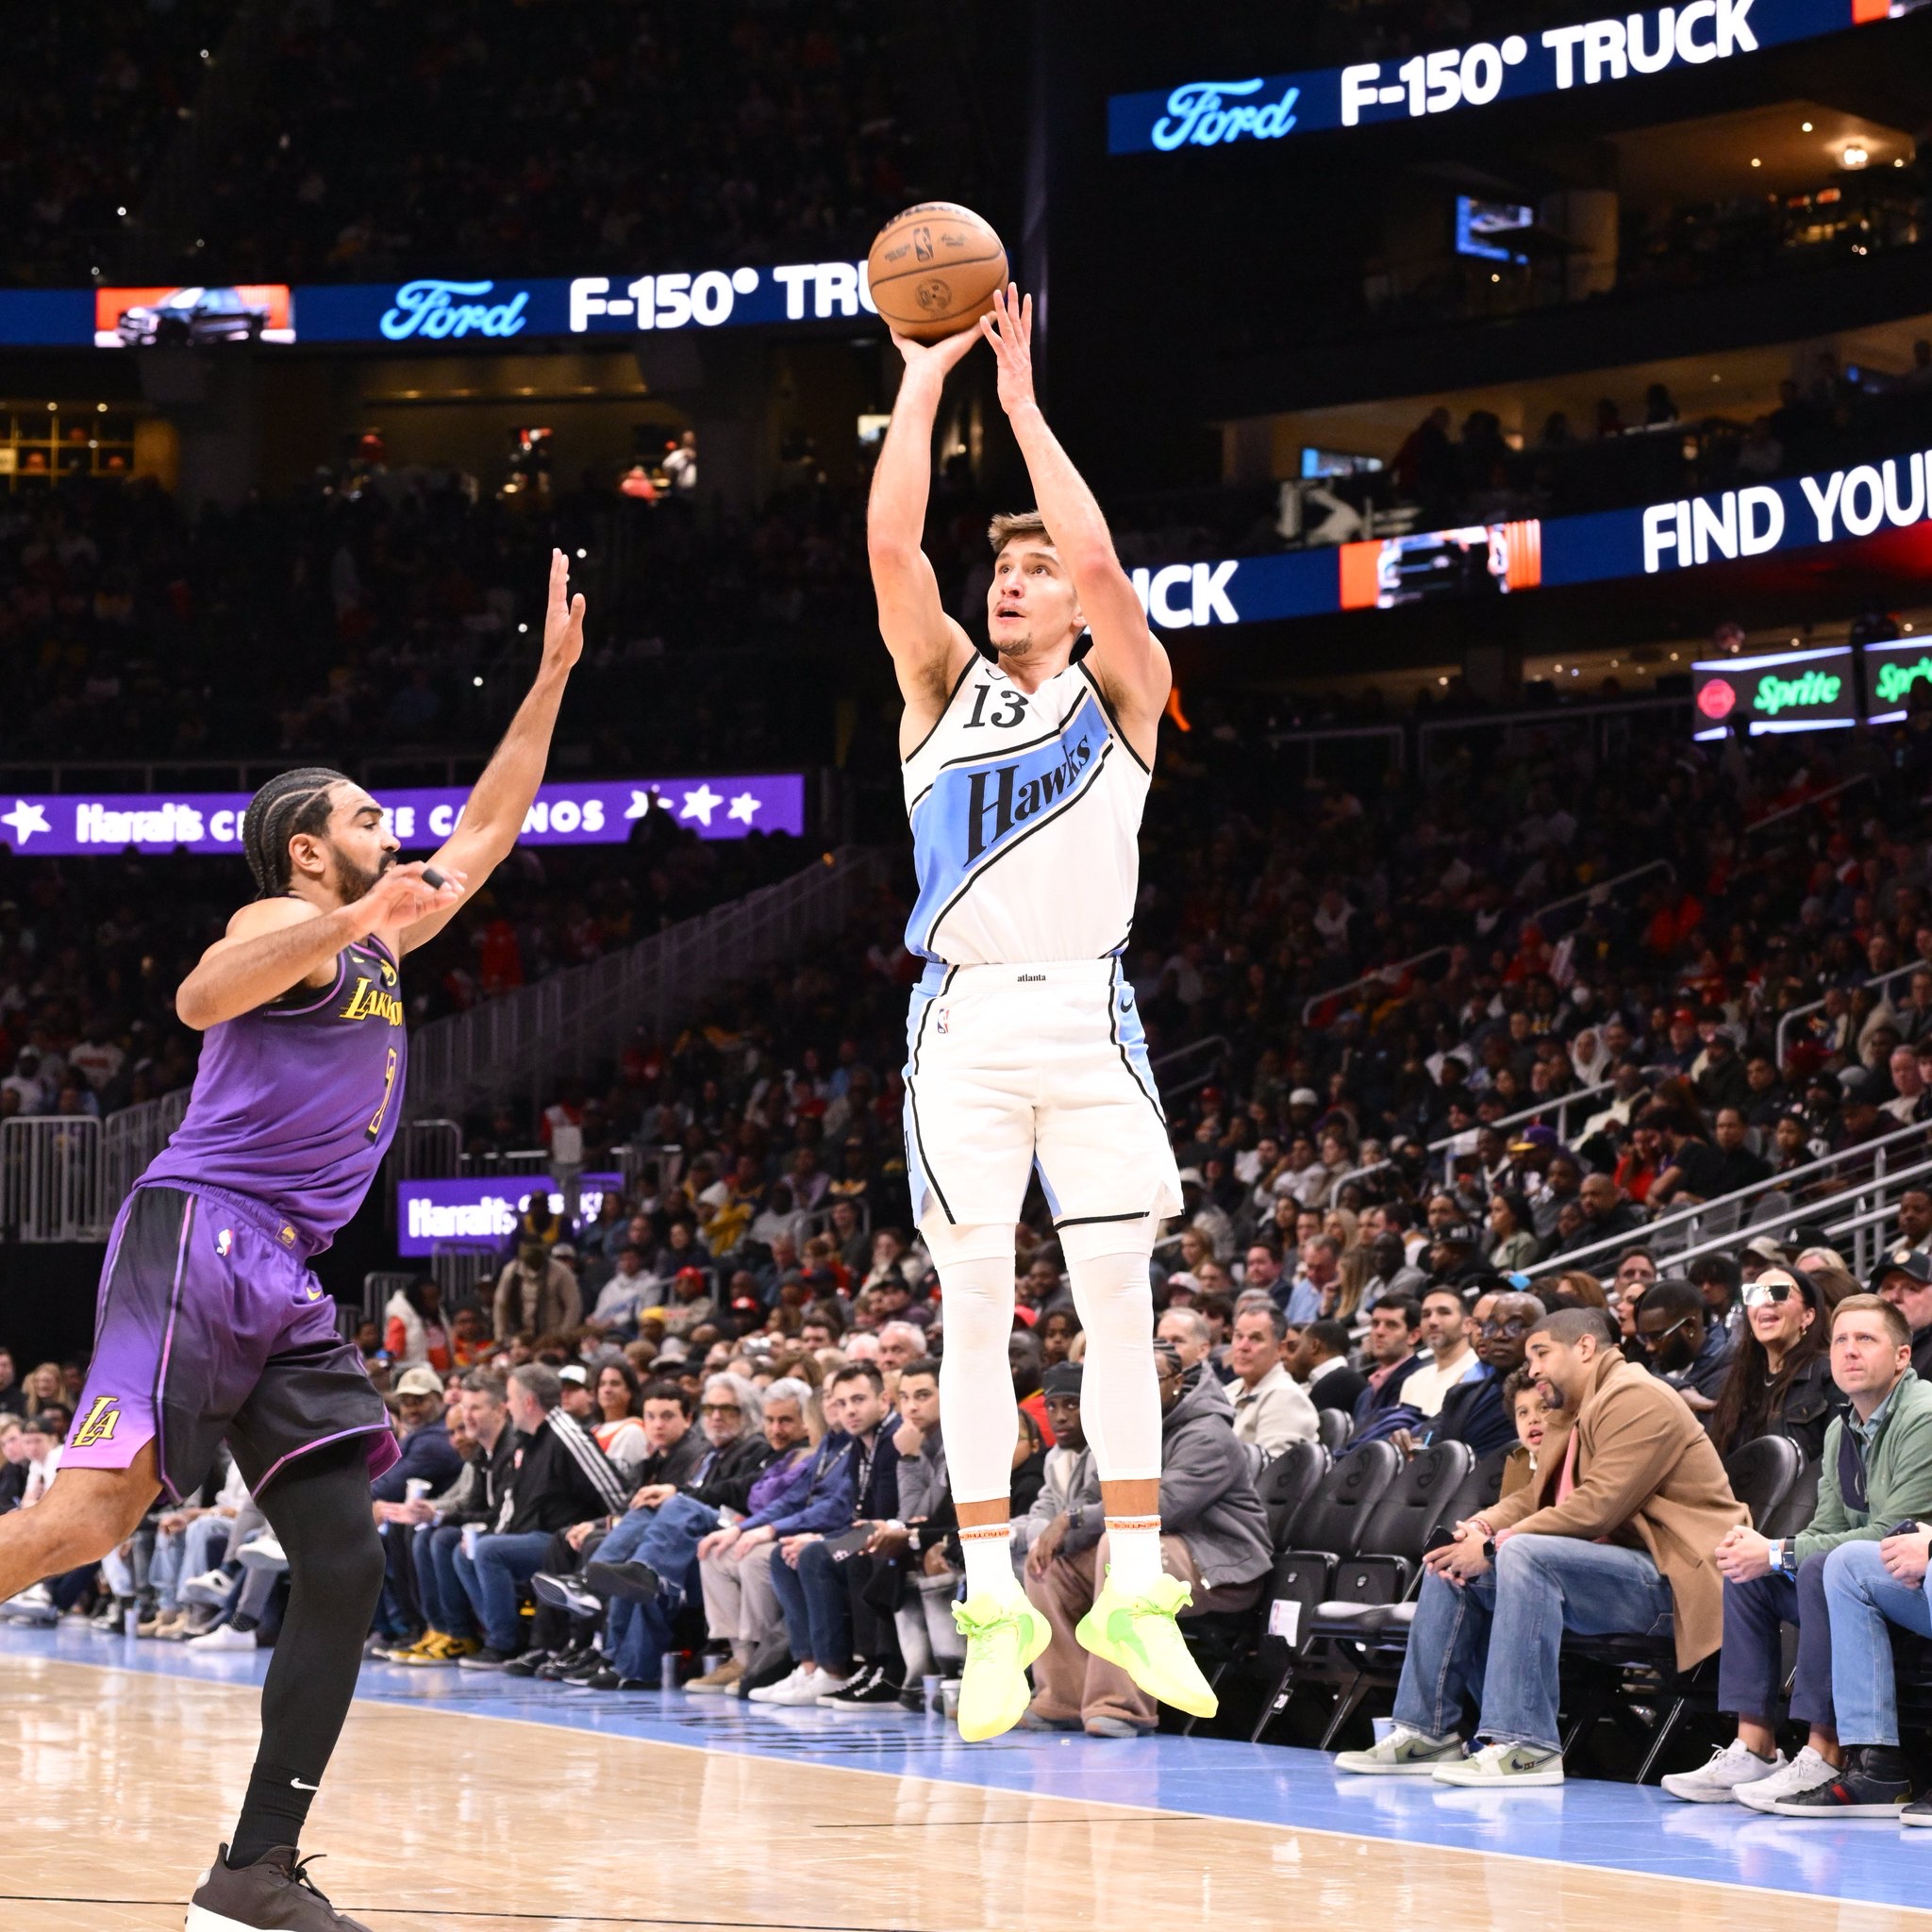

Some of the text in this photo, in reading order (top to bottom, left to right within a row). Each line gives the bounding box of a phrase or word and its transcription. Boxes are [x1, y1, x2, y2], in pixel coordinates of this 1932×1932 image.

[1541, 0, 1759, 90] TRUCK
[1151, 77, 1300, 151] Ford
[380, 279, 530, 341] Ford
[1642, 486, 1785, 574] FIND
[962, 684, 1029, 729] 13
[1753, 670, 1841, 715] Sprite
[962, 734, 1091, 869] Hawks
[1017, 973, 1046, 982] atlanta
[71, 1396, 121, 1448] LA
